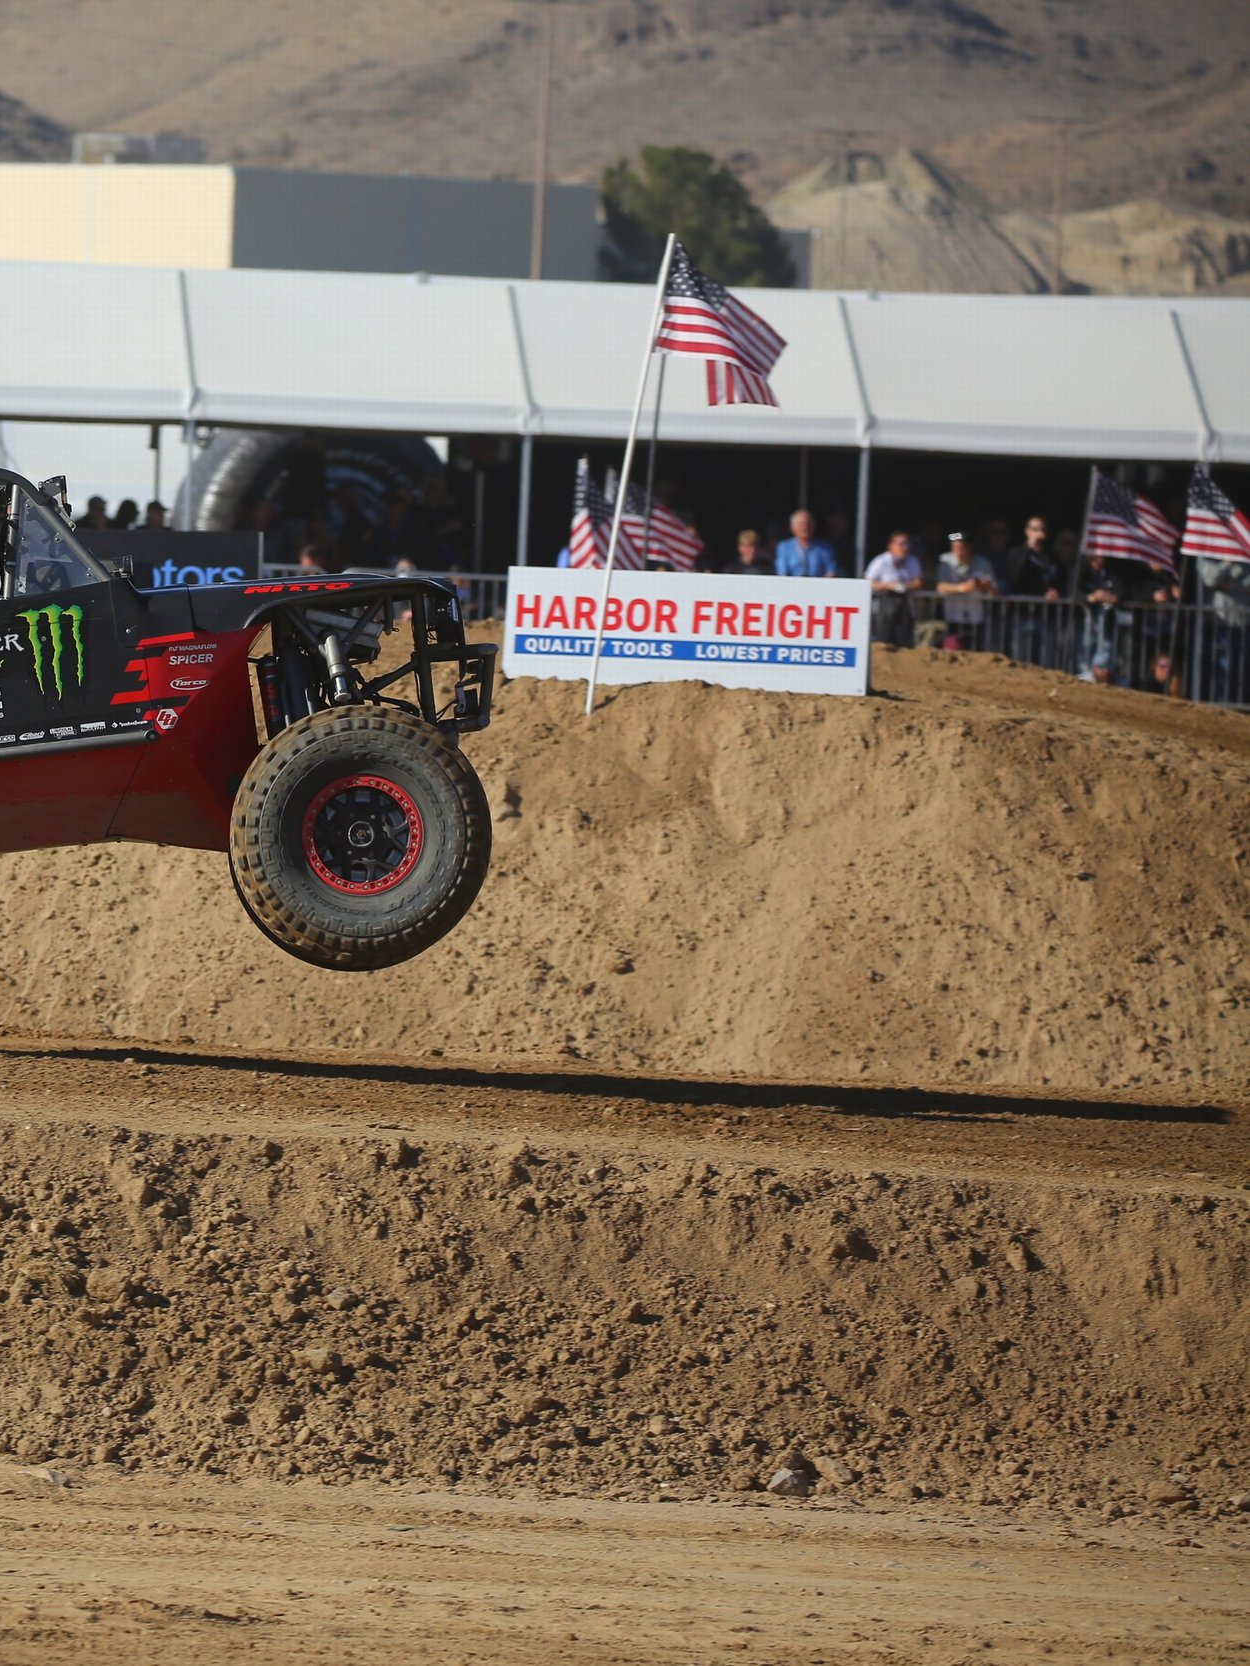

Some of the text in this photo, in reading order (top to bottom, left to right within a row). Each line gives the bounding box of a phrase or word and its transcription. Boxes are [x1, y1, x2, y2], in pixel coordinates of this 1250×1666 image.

[244, 582, 353, 594] NITTO
[515, 594, 860, 641] HARBOR FREIGHT
[168, 653, 214, 665] SPICER
[612, 640, 673, 658] TOOLS
[696, 644, 768, 661] LOWEST
[777, 647, 846, 664] PRICES
